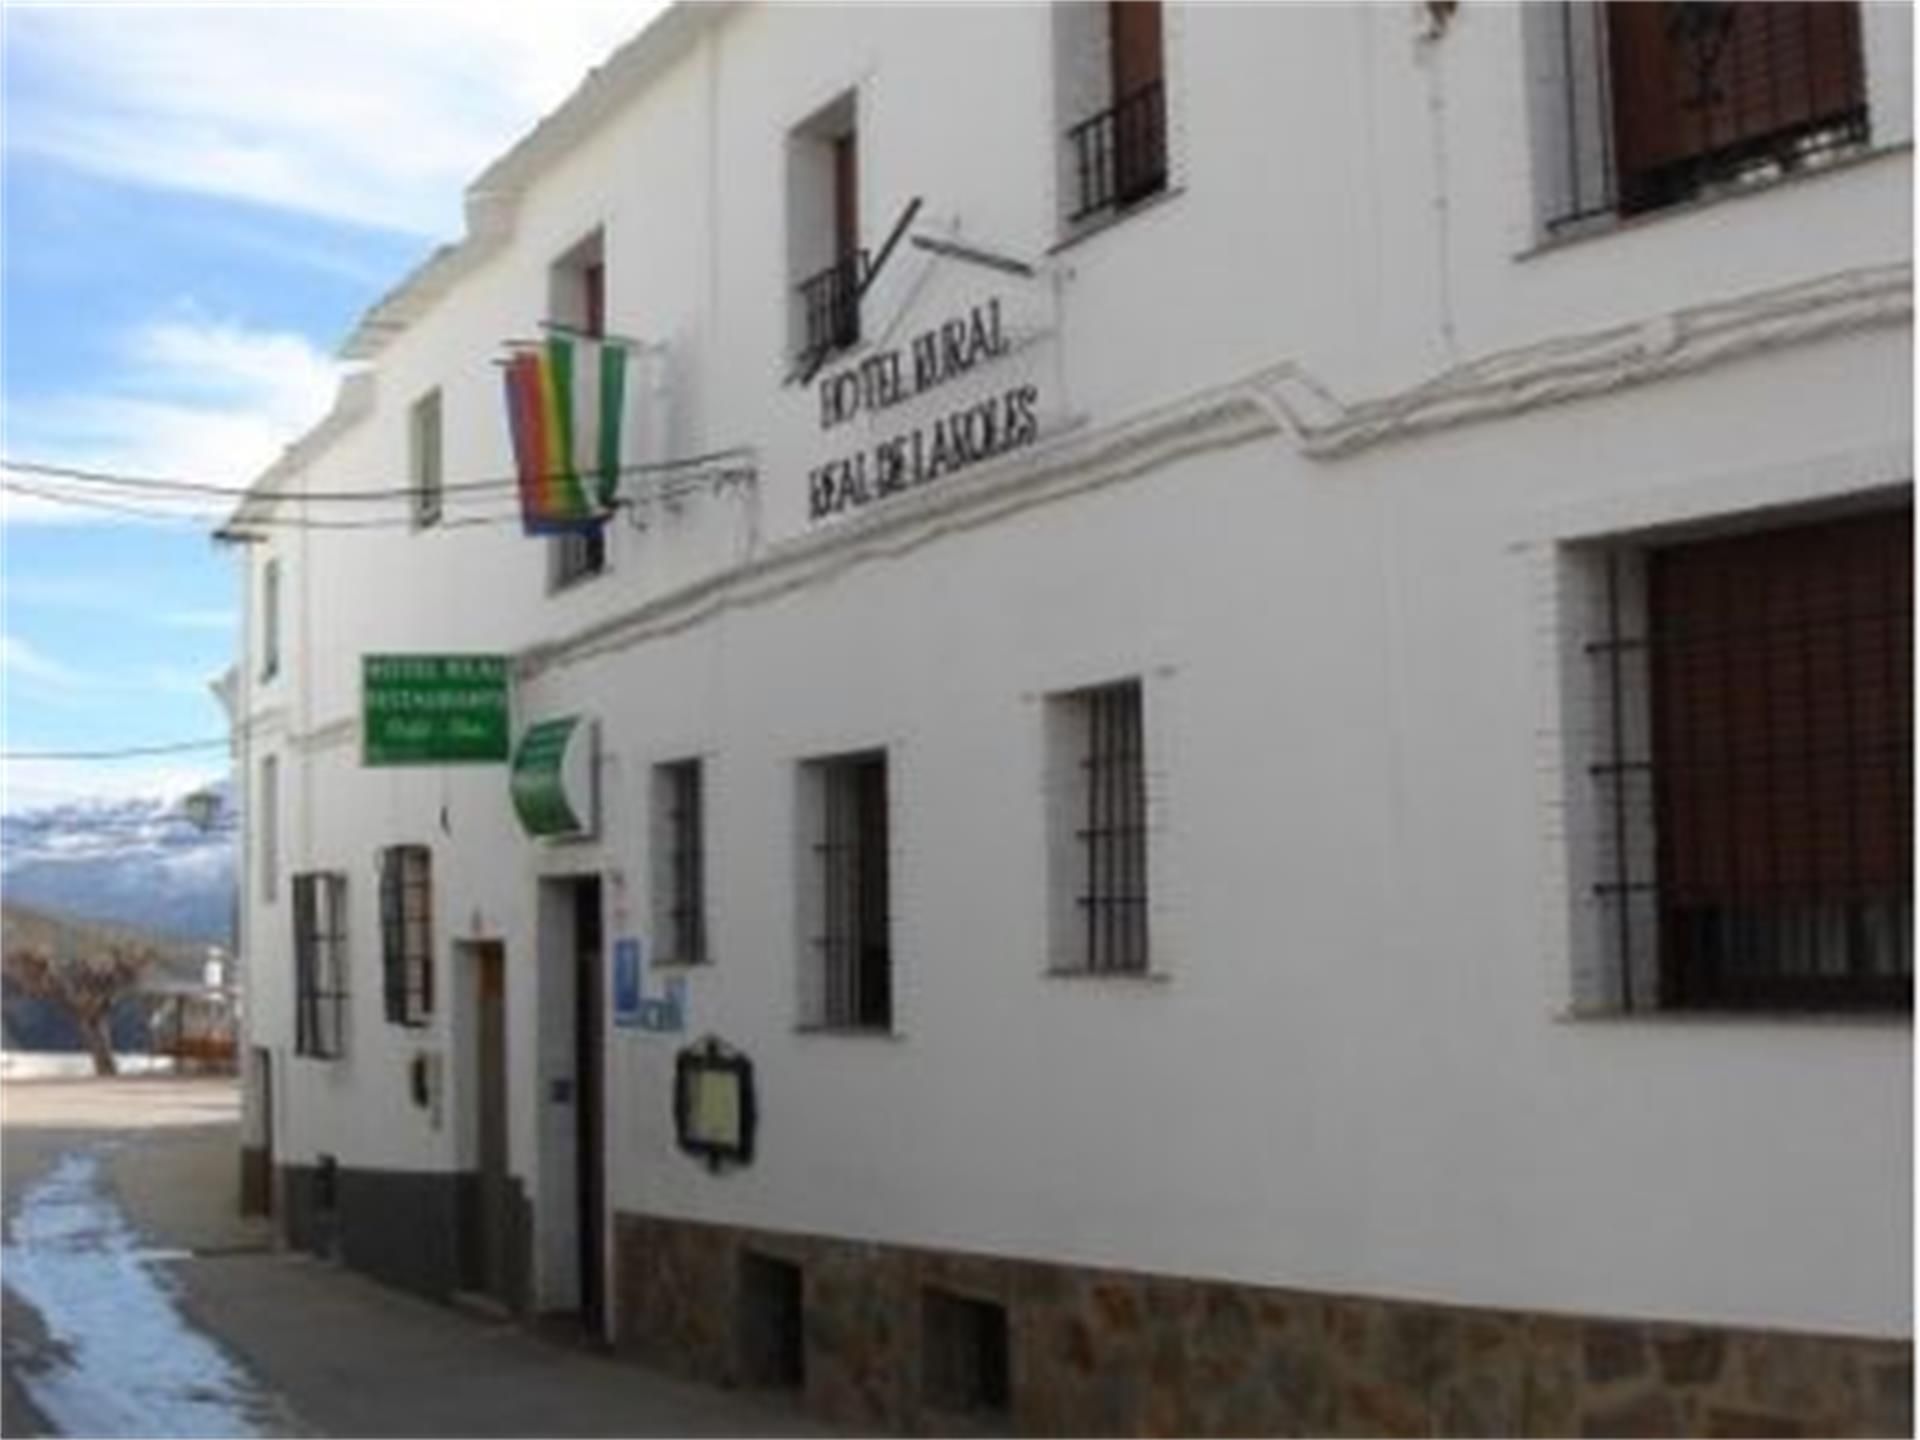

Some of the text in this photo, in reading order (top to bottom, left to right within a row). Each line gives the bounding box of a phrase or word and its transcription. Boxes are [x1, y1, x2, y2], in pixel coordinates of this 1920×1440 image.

[819, 296, 1010, 430] HOTEL RURAL
[807, 452, 873, 520] REAL
[876, 434, 909, 499] DE
